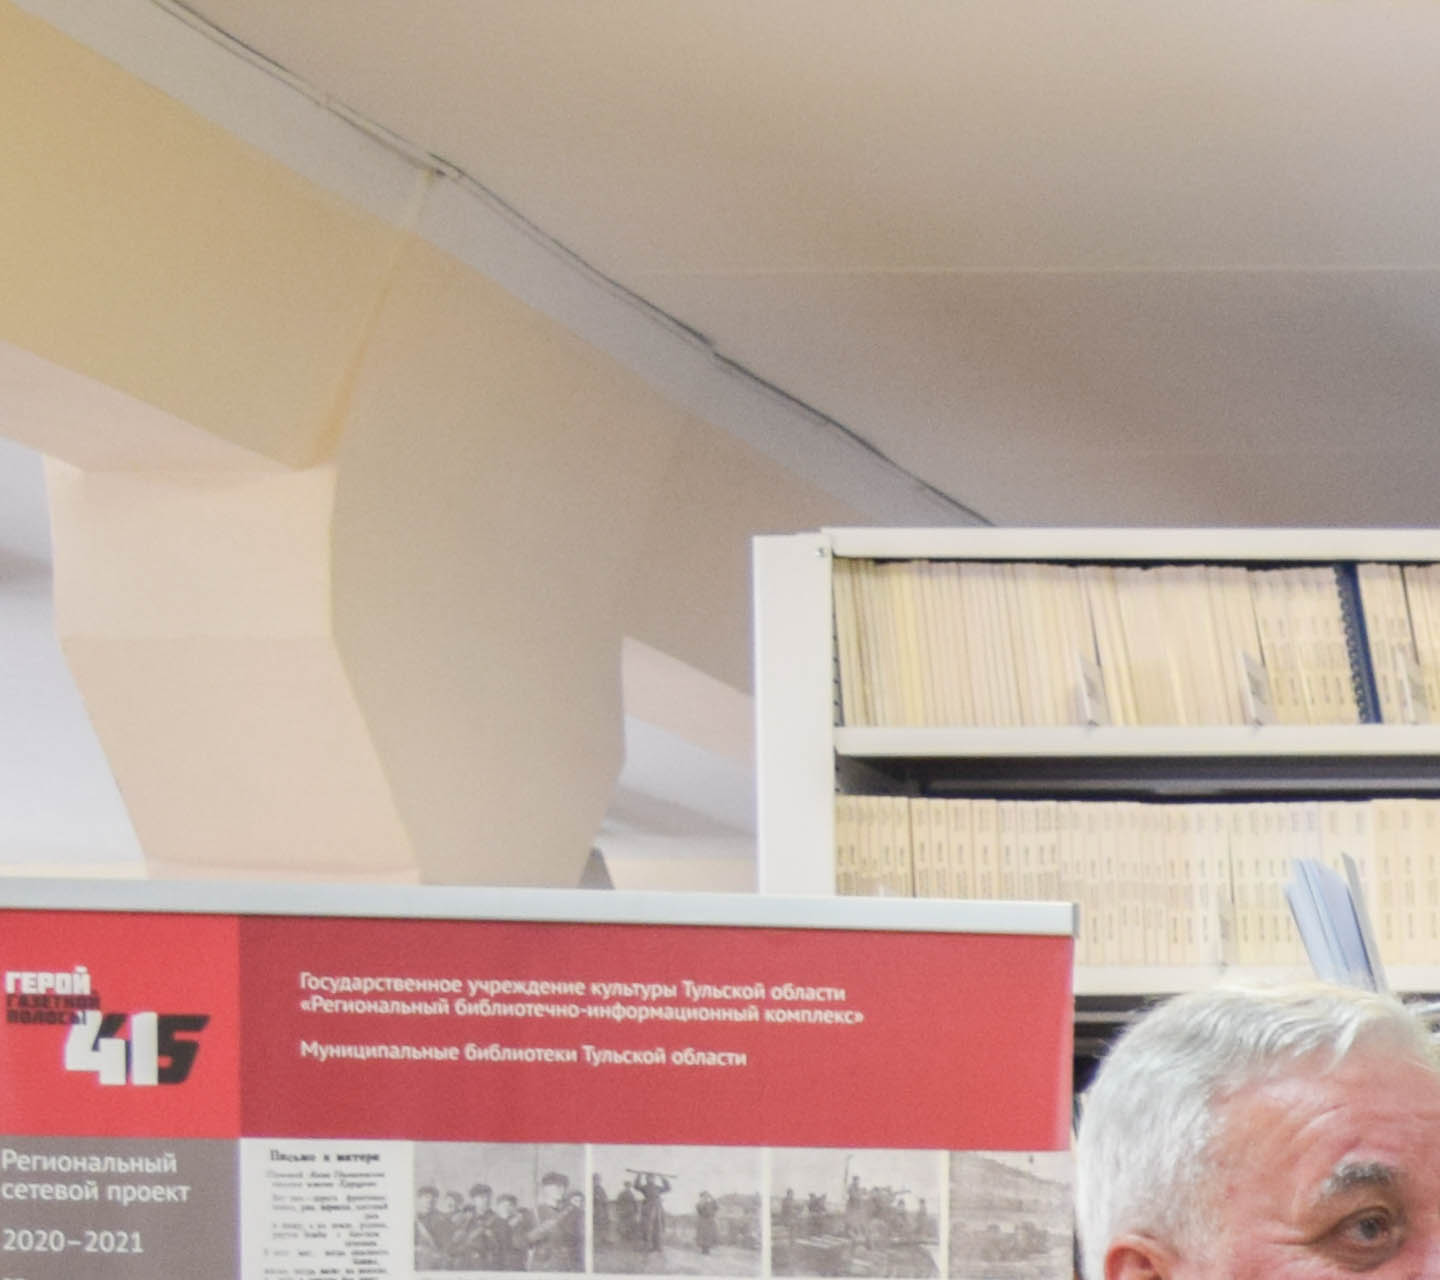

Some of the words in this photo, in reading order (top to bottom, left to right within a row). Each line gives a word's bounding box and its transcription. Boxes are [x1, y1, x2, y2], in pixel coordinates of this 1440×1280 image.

[5, 965, 91, 995] ГЕРОЙ
[299, 971, 463, 995] Государственное
[468, 981, 586, 998] учреждение
[591, 981, 678, 1001] культуры
[683, 980, 766, 1000] Тульской
[771, 983, 846, 1002] области
[300, 996, 450, 1018] «Региональный
[455, 998, 759, 1024] библиотечно-информационный
[764, 1007, 865, 1025] комплекс»
[299, 1040, 460, 1061] Муниципальные
[465, 1042, 578, 1062] библиотеки
[582, 1045, 666, 1066] Тульской
[671, 1046, 747, 1066] области
[1, 1148, 178, 1175] Региональный
[1, 1180, 100, 1201] сетевой
[107, 1183, 191, 1204] проект
